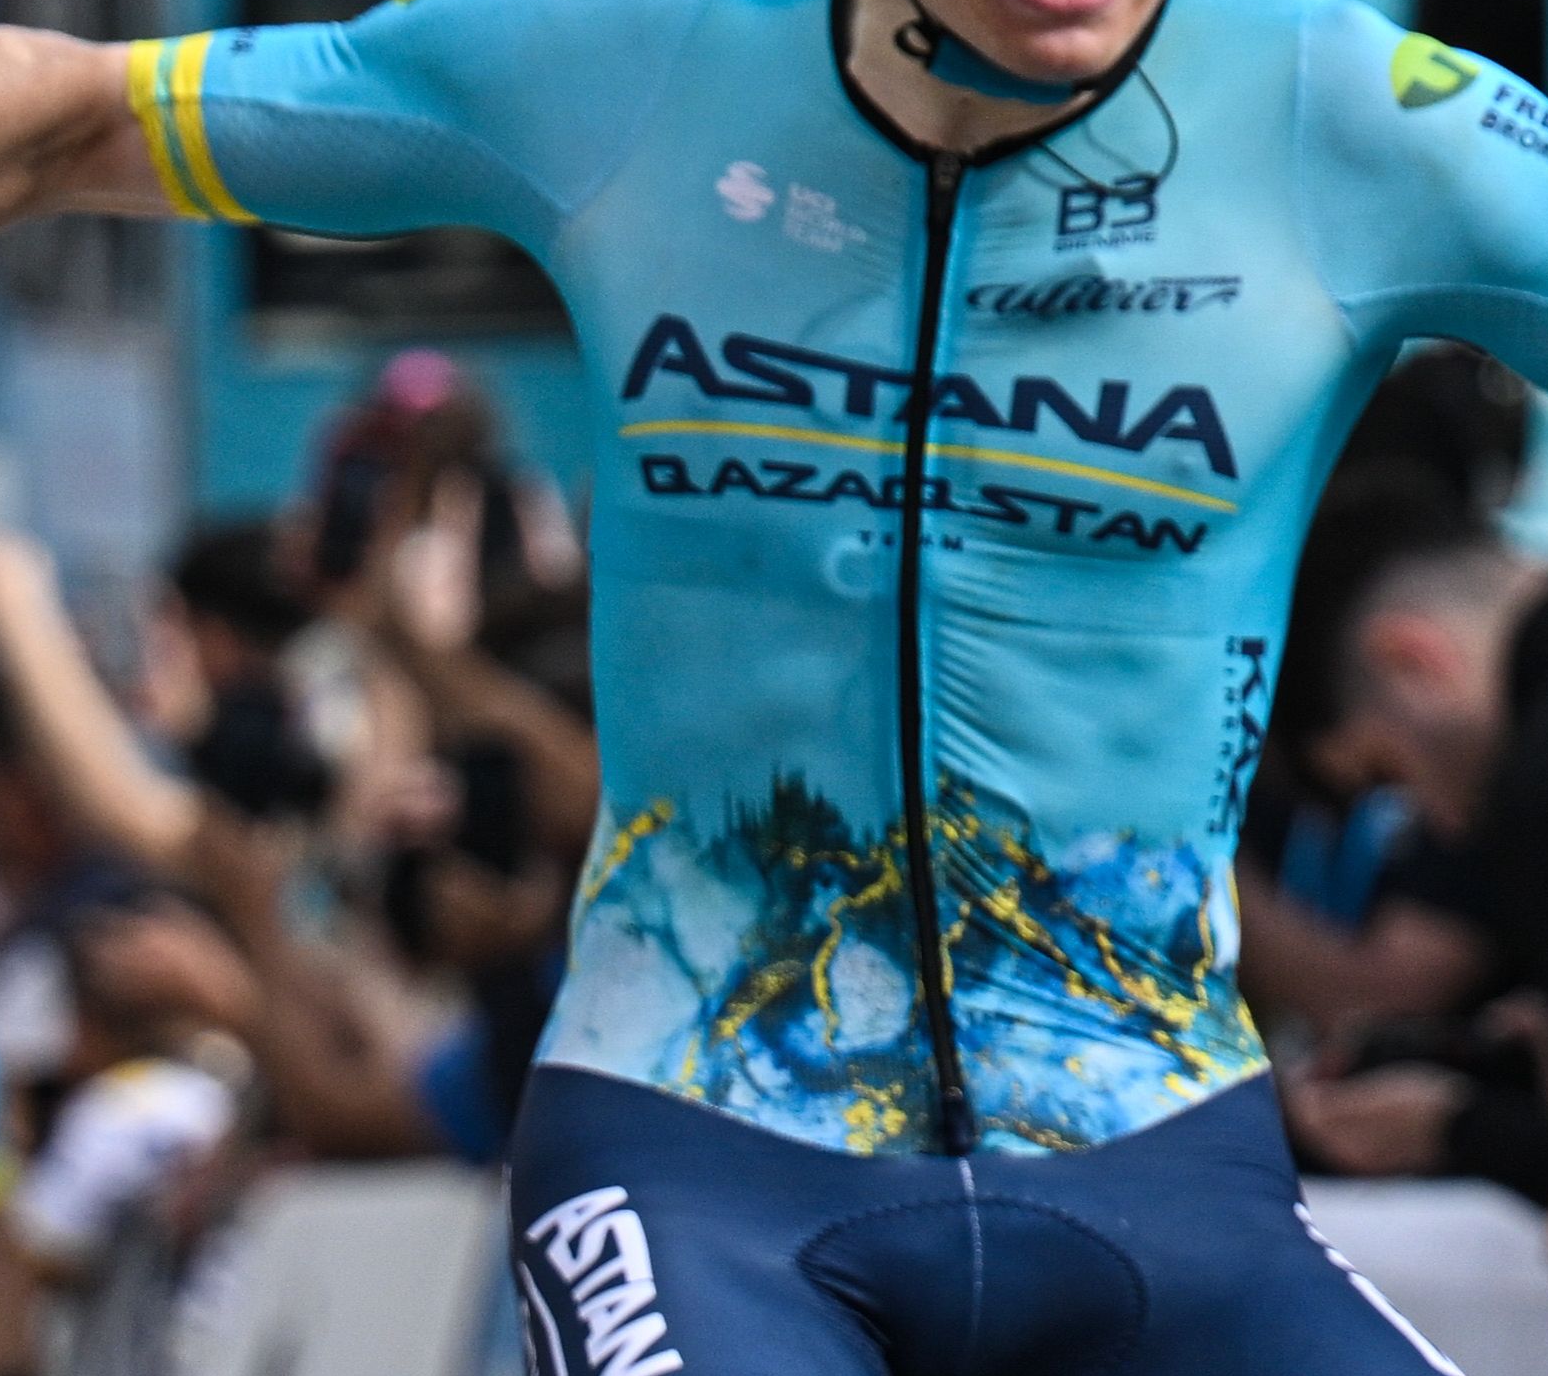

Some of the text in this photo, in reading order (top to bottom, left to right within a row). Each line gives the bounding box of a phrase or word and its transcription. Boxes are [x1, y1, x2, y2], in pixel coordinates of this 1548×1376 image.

[1057, 172, 1159, 236] B3
[619, 313, 1239, 481] ASTANA
[640, 455, 1211, 555] QAZAQSTAN
